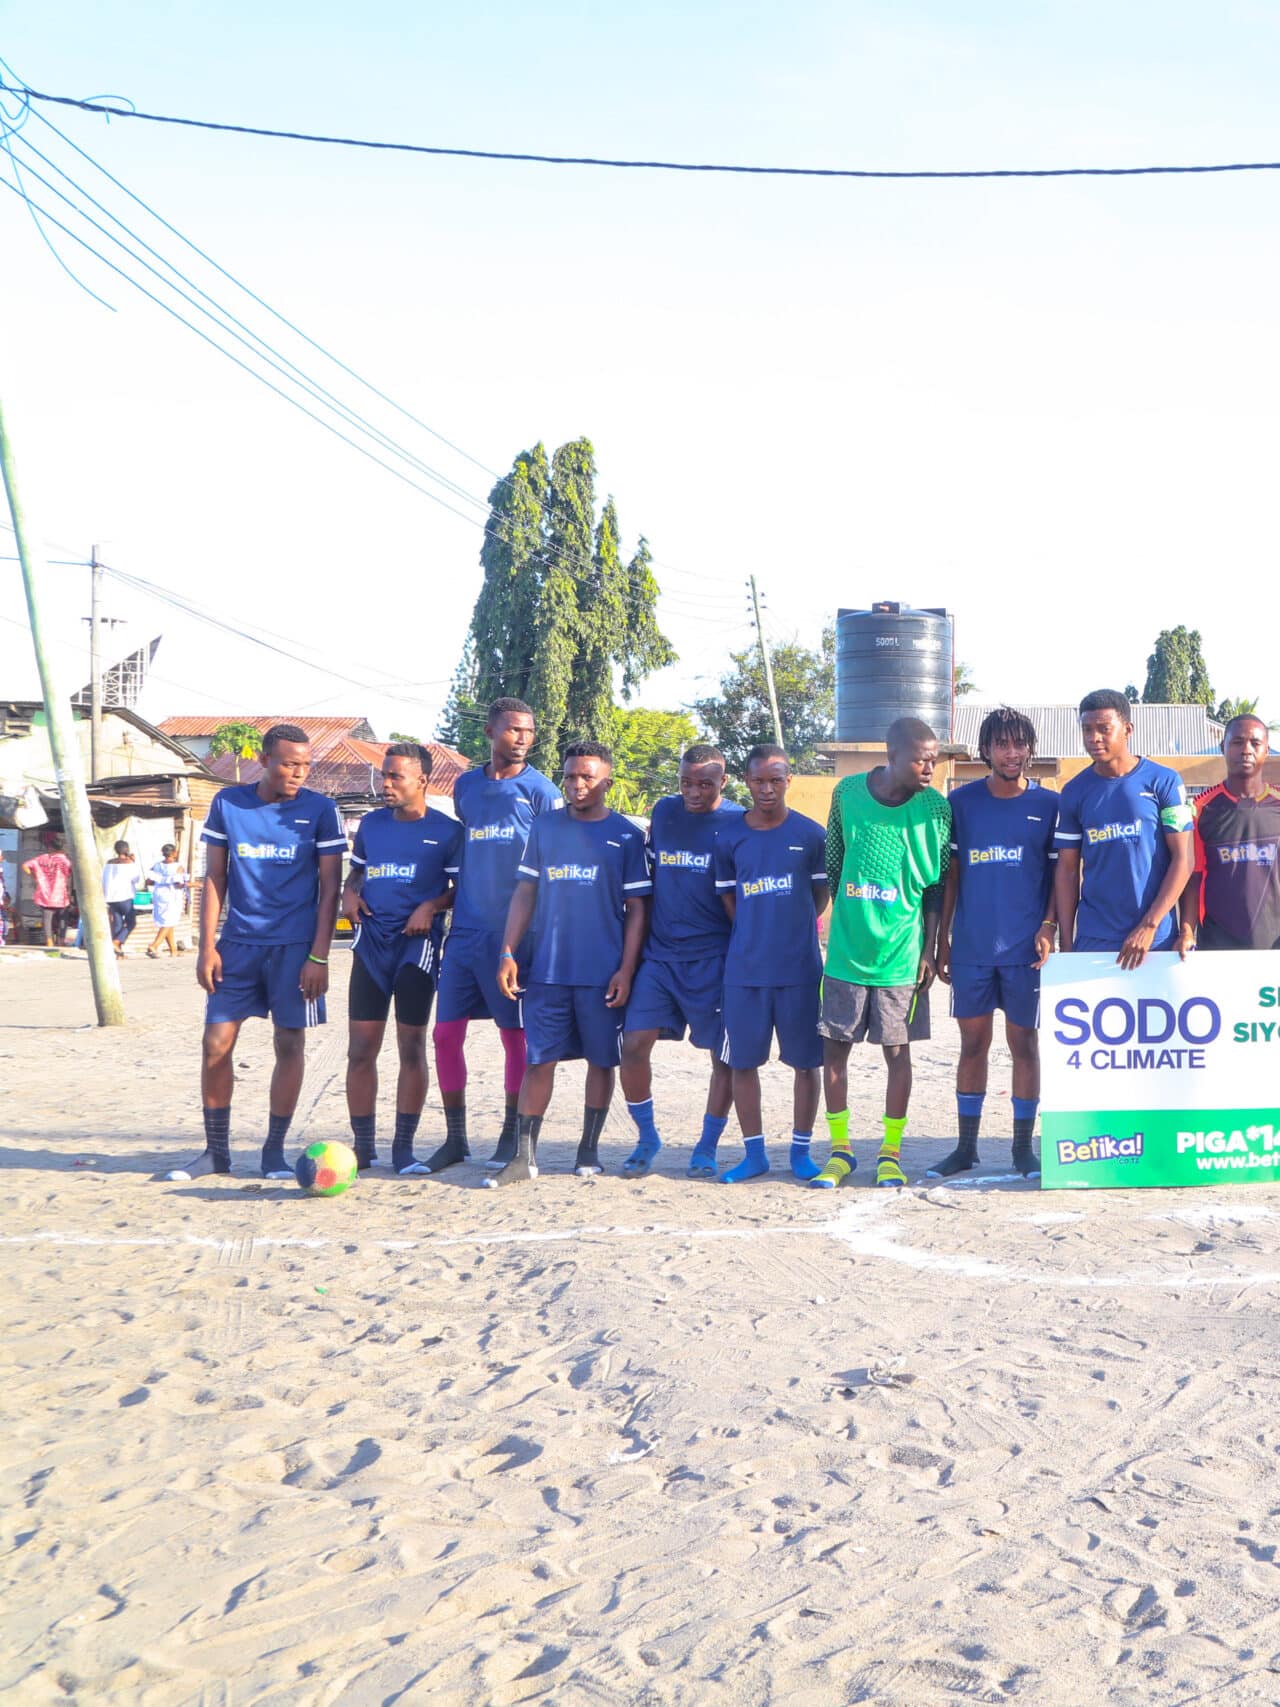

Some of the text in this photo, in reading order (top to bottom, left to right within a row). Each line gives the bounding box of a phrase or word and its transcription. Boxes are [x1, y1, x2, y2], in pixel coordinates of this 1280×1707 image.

[1087, 819, 1141, 843] Betika!
[237, 843, 297, 860] Betika!
[660, 851, 711, 868] Betika!
[969, 847, 1022, 864] Betika!
[367, 863, 415, 879] Betika!
[547, 864, 598, 880] Betika!
[743, 873, 792, 897] Betika!
[846, 883, 898, 902] Betika!
[1054, 996, 1222, 1046] SODO
[1066, 1049, 1206, 1070] 4 CLIMATE
[1058, 1133, 1142, 1163] Betika!
